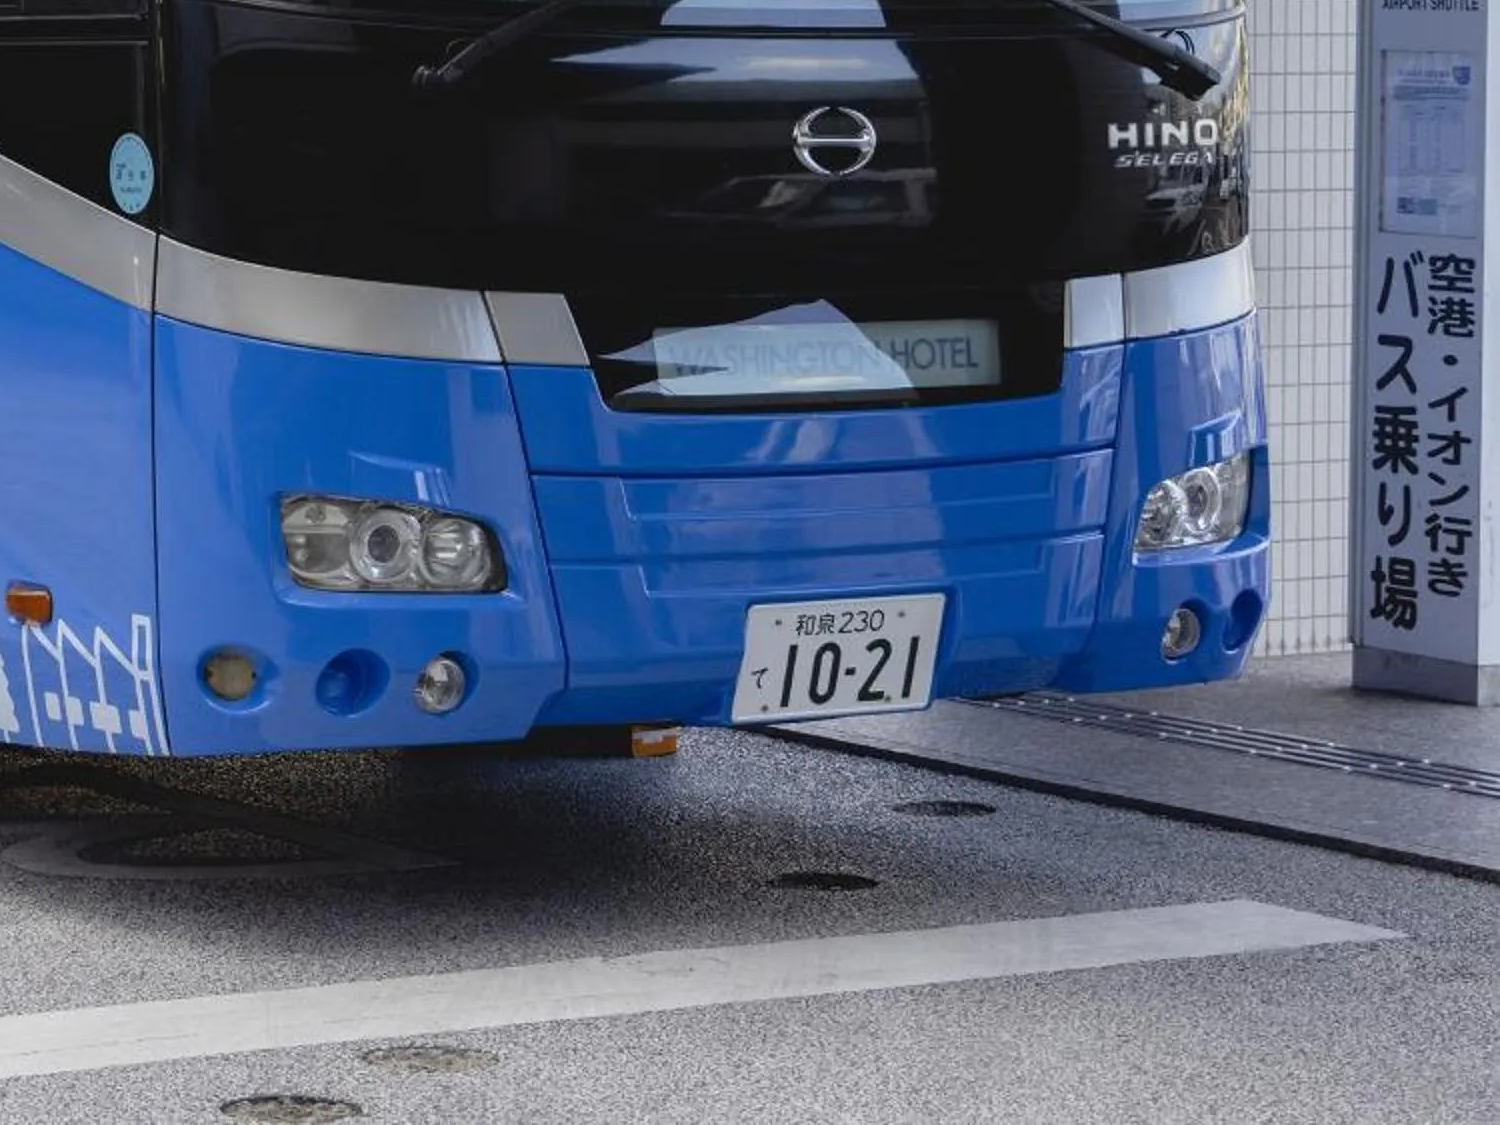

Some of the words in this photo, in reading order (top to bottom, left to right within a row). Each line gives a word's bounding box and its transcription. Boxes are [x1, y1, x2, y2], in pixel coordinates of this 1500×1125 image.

[1107, 118, 1219, 149] HINO
[666, 338, 884, 378] WASHINGTON
[889, 336, 979, 372] HOTEL
[1370, 250, 1424, 631] バス乗り場
[1424, 252, 1477, 598] 空港・イオン行き
[752, 667, 769, 690] て
[779, 635, 920, 709] 10-21
